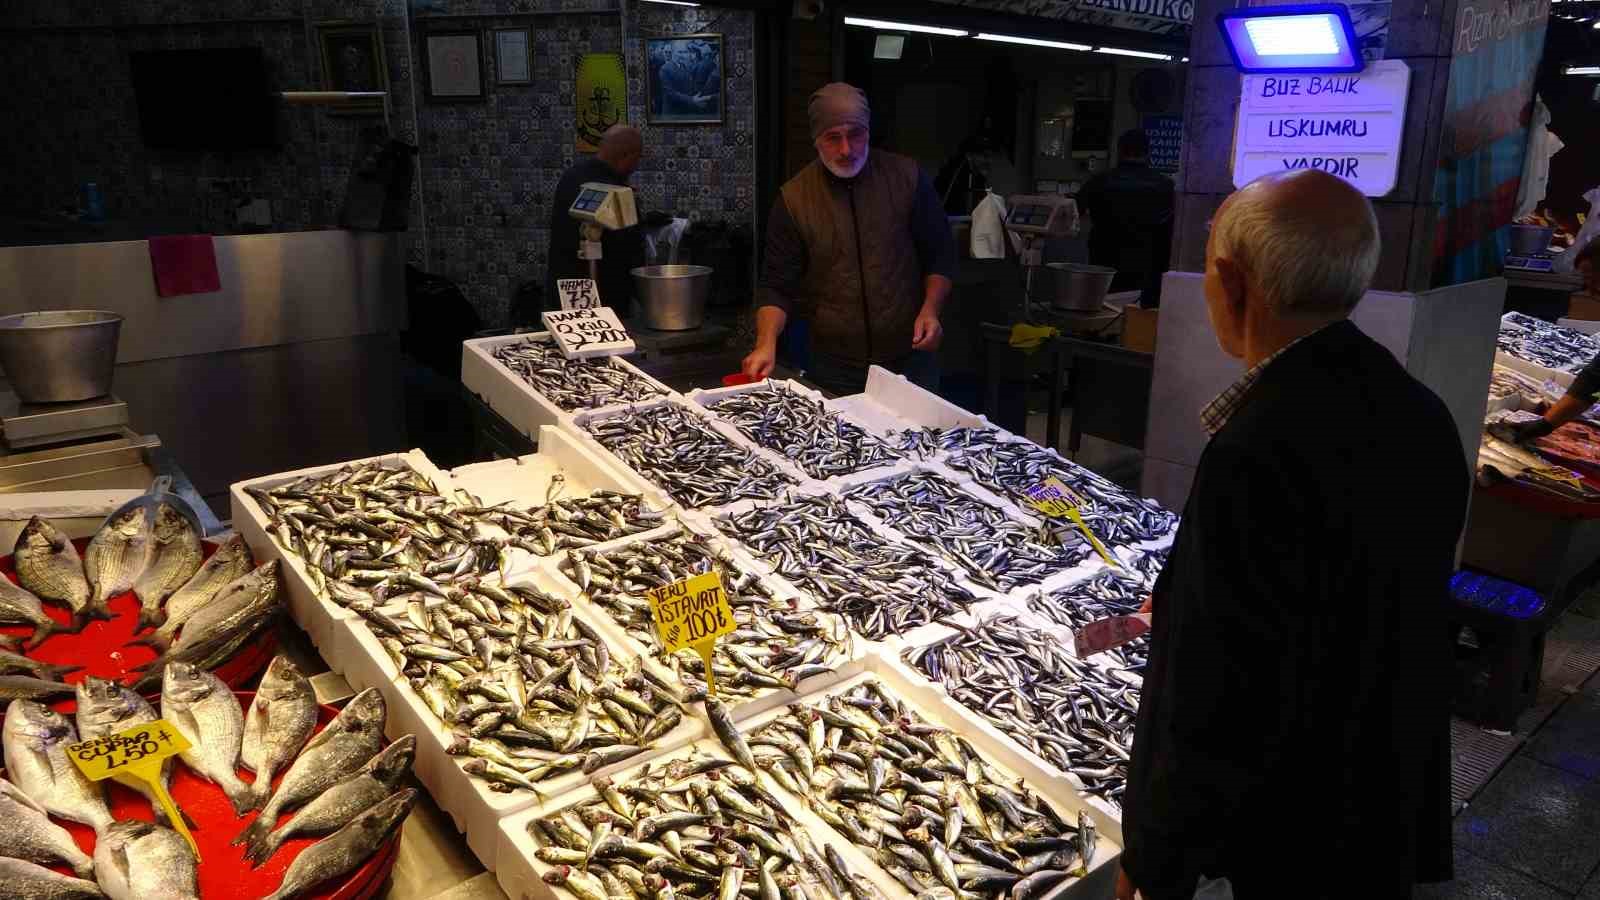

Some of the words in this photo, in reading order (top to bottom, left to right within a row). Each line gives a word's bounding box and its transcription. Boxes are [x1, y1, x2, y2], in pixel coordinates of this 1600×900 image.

[1262, 78, 1300, 97] BUZ
[1307, 76, 1360, 95] BALIK
[1269, 119, 1367, 137] USKUMRU
